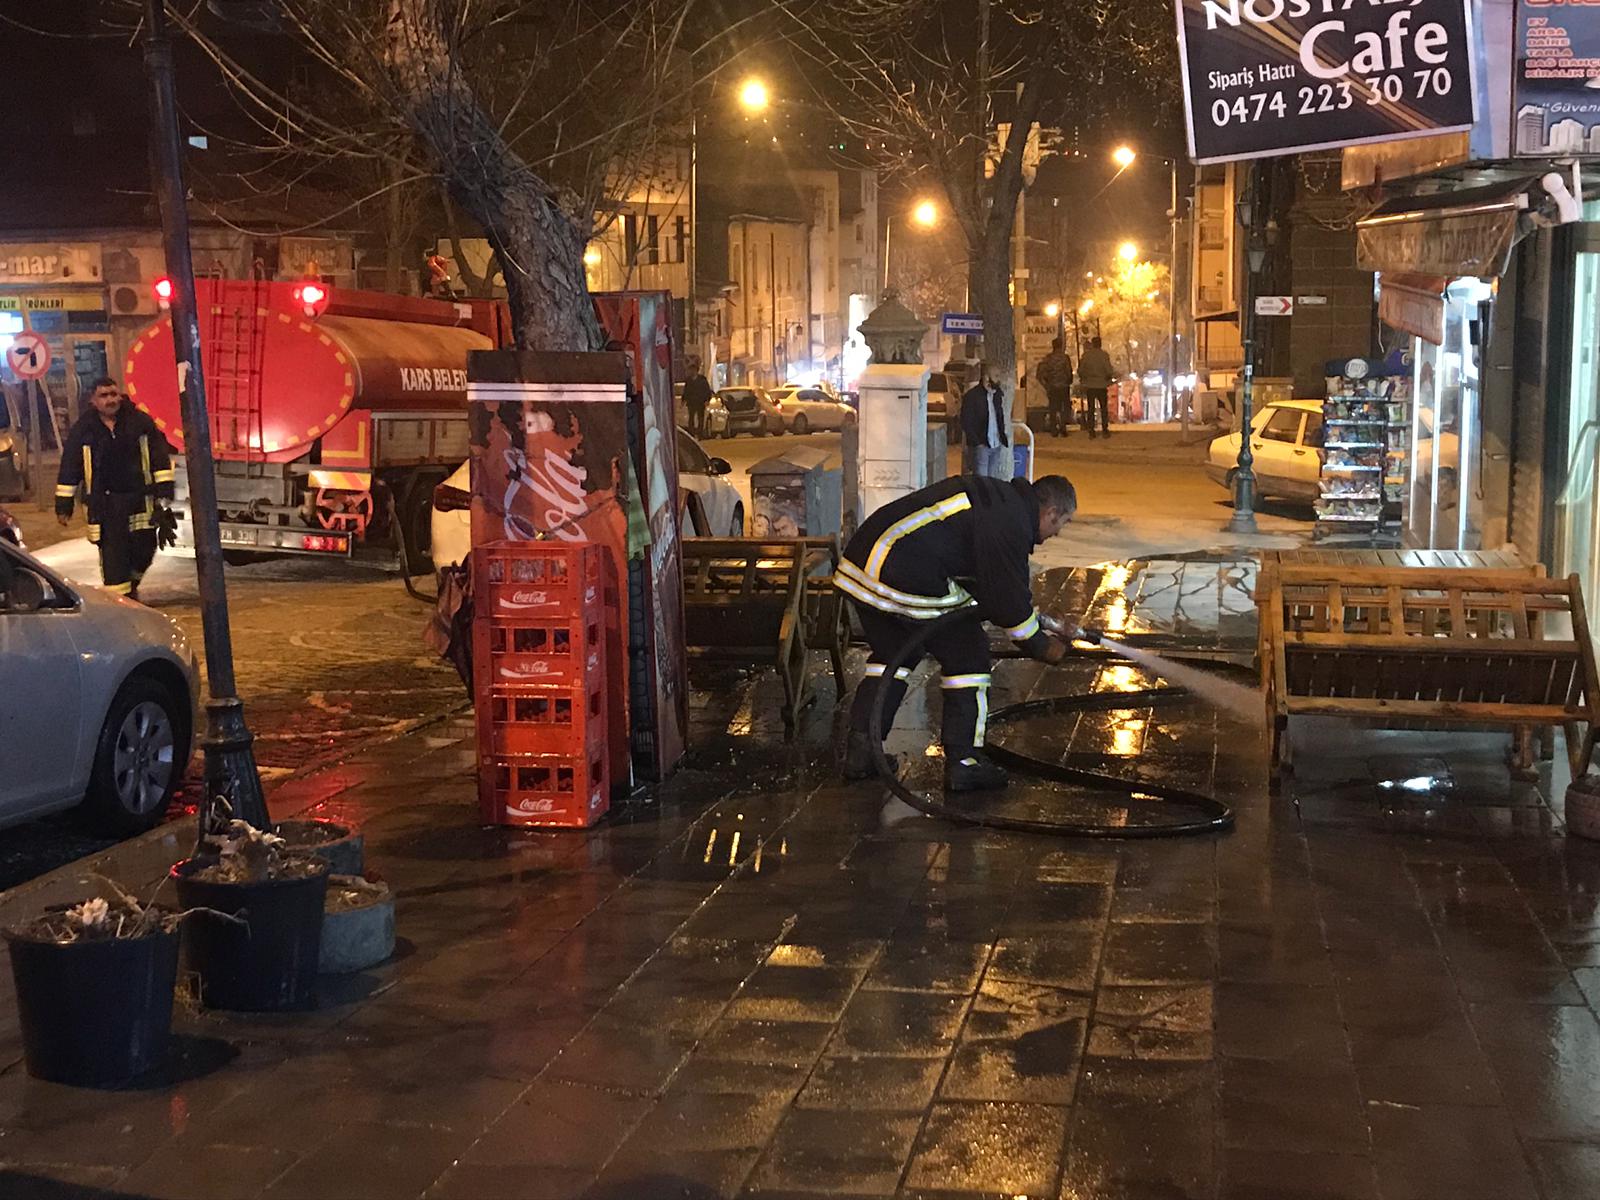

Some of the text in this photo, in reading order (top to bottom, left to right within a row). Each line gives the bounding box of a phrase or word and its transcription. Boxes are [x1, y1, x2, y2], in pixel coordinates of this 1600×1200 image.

[1527, 17, 1548, 26] EV
[1526, 27, 1567, 36] ARSA
[1299, 10, 1449, 79] Cafe
[1526, 37, 1570, 47] DAİRE
[1526, 48, 1573, 57] TARLA
[1558, 58, 1600, 68] BAHÇ
[1208, 63, 1295, 90] Sipariş Hattı
[1525, 68, 1585, 78] KİRALIK
[1211, 68, 1452, 126] 0474 223 30 70
[400, 367, 468, 391] KARS BELED
[513, 591, 547, 603] Coca-Cola
[520, 798, 555, 811] Coca-Cola
